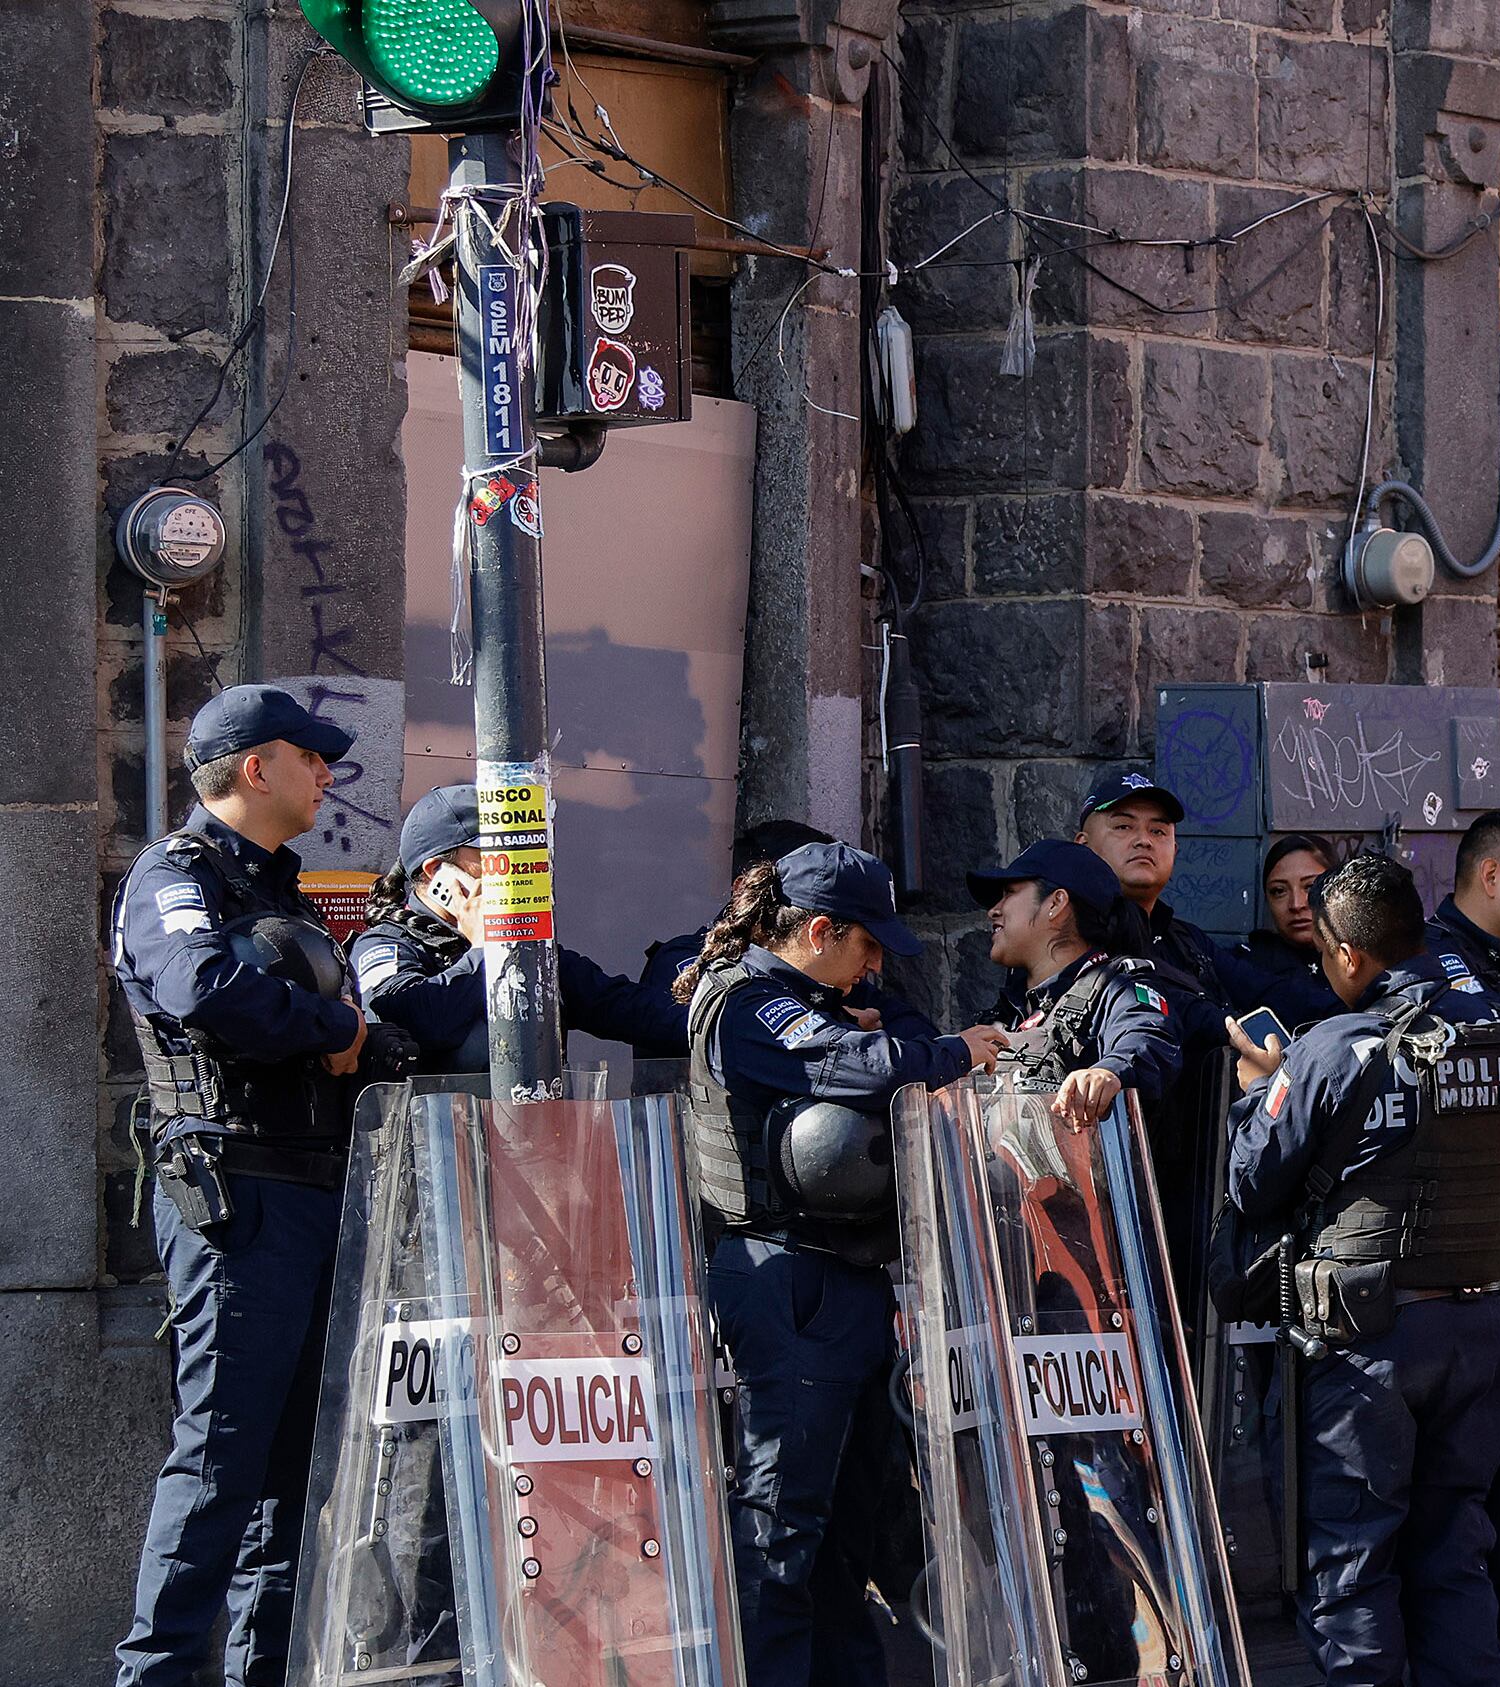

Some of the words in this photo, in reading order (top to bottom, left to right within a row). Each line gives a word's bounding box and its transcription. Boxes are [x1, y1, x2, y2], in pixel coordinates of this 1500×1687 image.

[597, 288, 626, 307] BUM
[599, 306, 626, 324] PER
[488, 300, 511, 355] SEM
[492, 361, 512, 448] 1811
[480, 788, 531, 803] BUSCO
[480, 809, 546, 825] ERSONAL
[504, 834, 546, 846] SABADO
[511, 897, 531, 905] 2347
[1024, 1349, 1134, 1420] POLICIA
[502, 1375, 653, 1446] POLICIA
